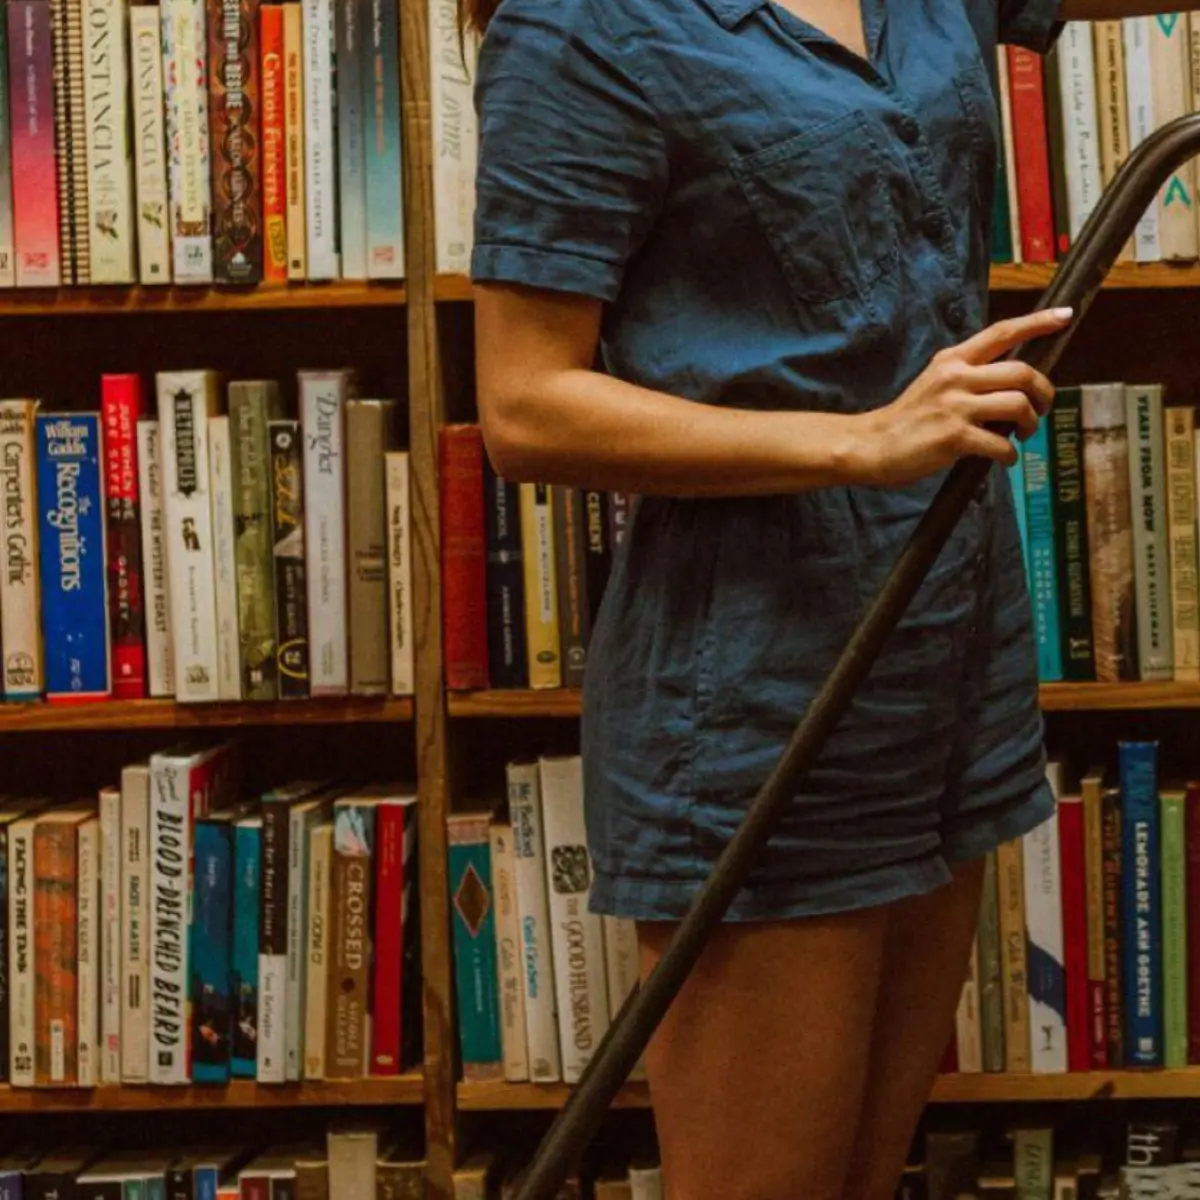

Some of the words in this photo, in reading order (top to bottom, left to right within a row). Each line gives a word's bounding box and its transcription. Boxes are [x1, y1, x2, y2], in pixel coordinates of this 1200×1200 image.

[139, 30, 156, 167] CONSTANCIA
[226, 64, 243, 108] DESIRE
[263, 53, 281, 121] CARLOS
[229, 120, 242, 166] CARLOS
[264, 127, 282, 205] FUENTES
[231, 170, 244, 222] FUENTES
[270, 221, 286, 263] USED
[45, 421, 88, 439] William
[107, 404, 119, 438] ARE
[119, 402, 133, 439] JUST
[308, 393, 338, 474] Dangler
[1137, 395, 1151, 440] YEARS
[48, 438, 87, 455] Gaddis
[121, 445, 134, 491] WHEN
[145, 429, 157, 459] Peter
[175, 401, 196, 488] METROPOLIS
[1140, 447, 1153, 488] FROM
[3, 441, 24, 528] Carpenter's
[109, 449, 121, 519] SAFEST
[123, 497, 134, 519] WE
[46, 461, 87, 591] Recognitions
[151, 509, 163, 531] THE
[587, 492, 601, 553] CEMENT
[1142, 495, 1155, 532] NOW
[7, 533, 31, 585] Gothic
[151, 535, 165, 590] MYSTERY
[117, 556, 129, 620] GADNEY
[154, 594, 166, 633] ROAST
[519, 805, 536, 858] Bedford
[15, 837, 27, 895] FACING
[156, 810, 185, 972] BLOOD-DRENCHED
[1135, 822, 1149, 913] LEMONADE
[16, 898, 27, 929] THE
[345, 863, 365, 970] CROSSED
[523, 916, 537, 945] Gail
[1136, 917, 1150, 950] ANN
[16, 933, 28, 974] TANK
[561, 920, 586, 969] GOOD
[525, 947, 540, 999] Godwin
[1137, 954, 1151, 1017] GOETHE
[153, 977, 183, 1047] BEARD
[570, 976, 593, 1050] HUSBAND
